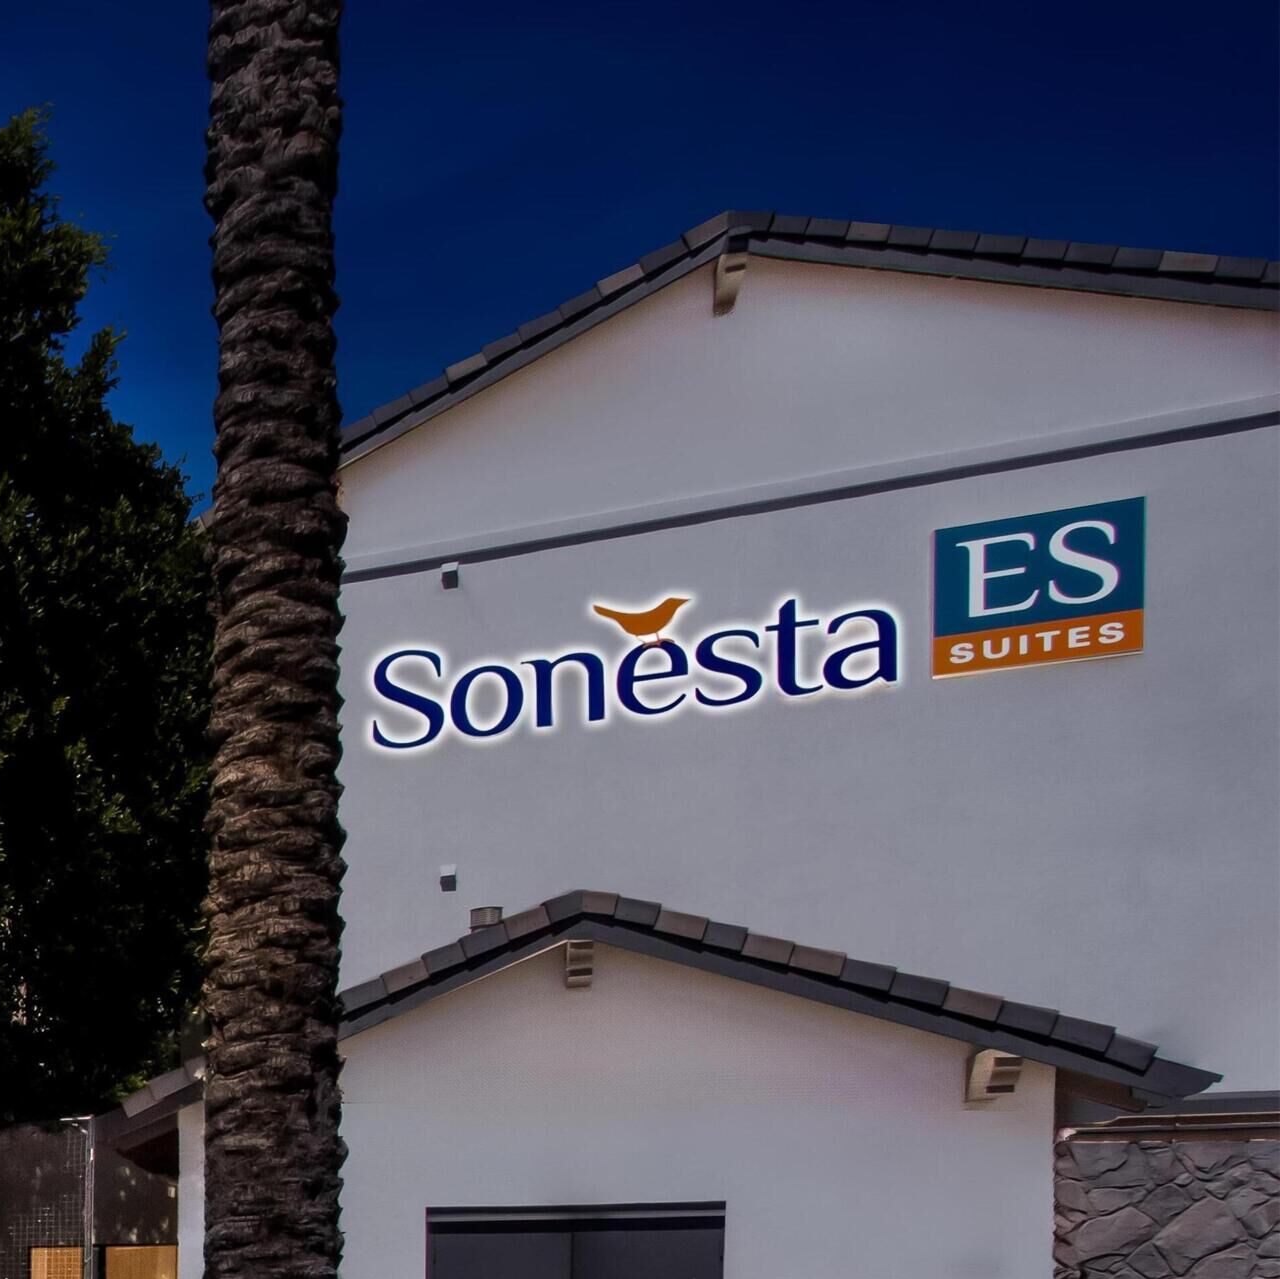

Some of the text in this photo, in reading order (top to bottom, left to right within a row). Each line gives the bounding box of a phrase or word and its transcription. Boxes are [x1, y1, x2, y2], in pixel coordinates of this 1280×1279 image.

[956, 519, 1120, 617] ES
[372, 598, 898, 748] Sonesta
[948, 621, 1125, 665] SUITES
